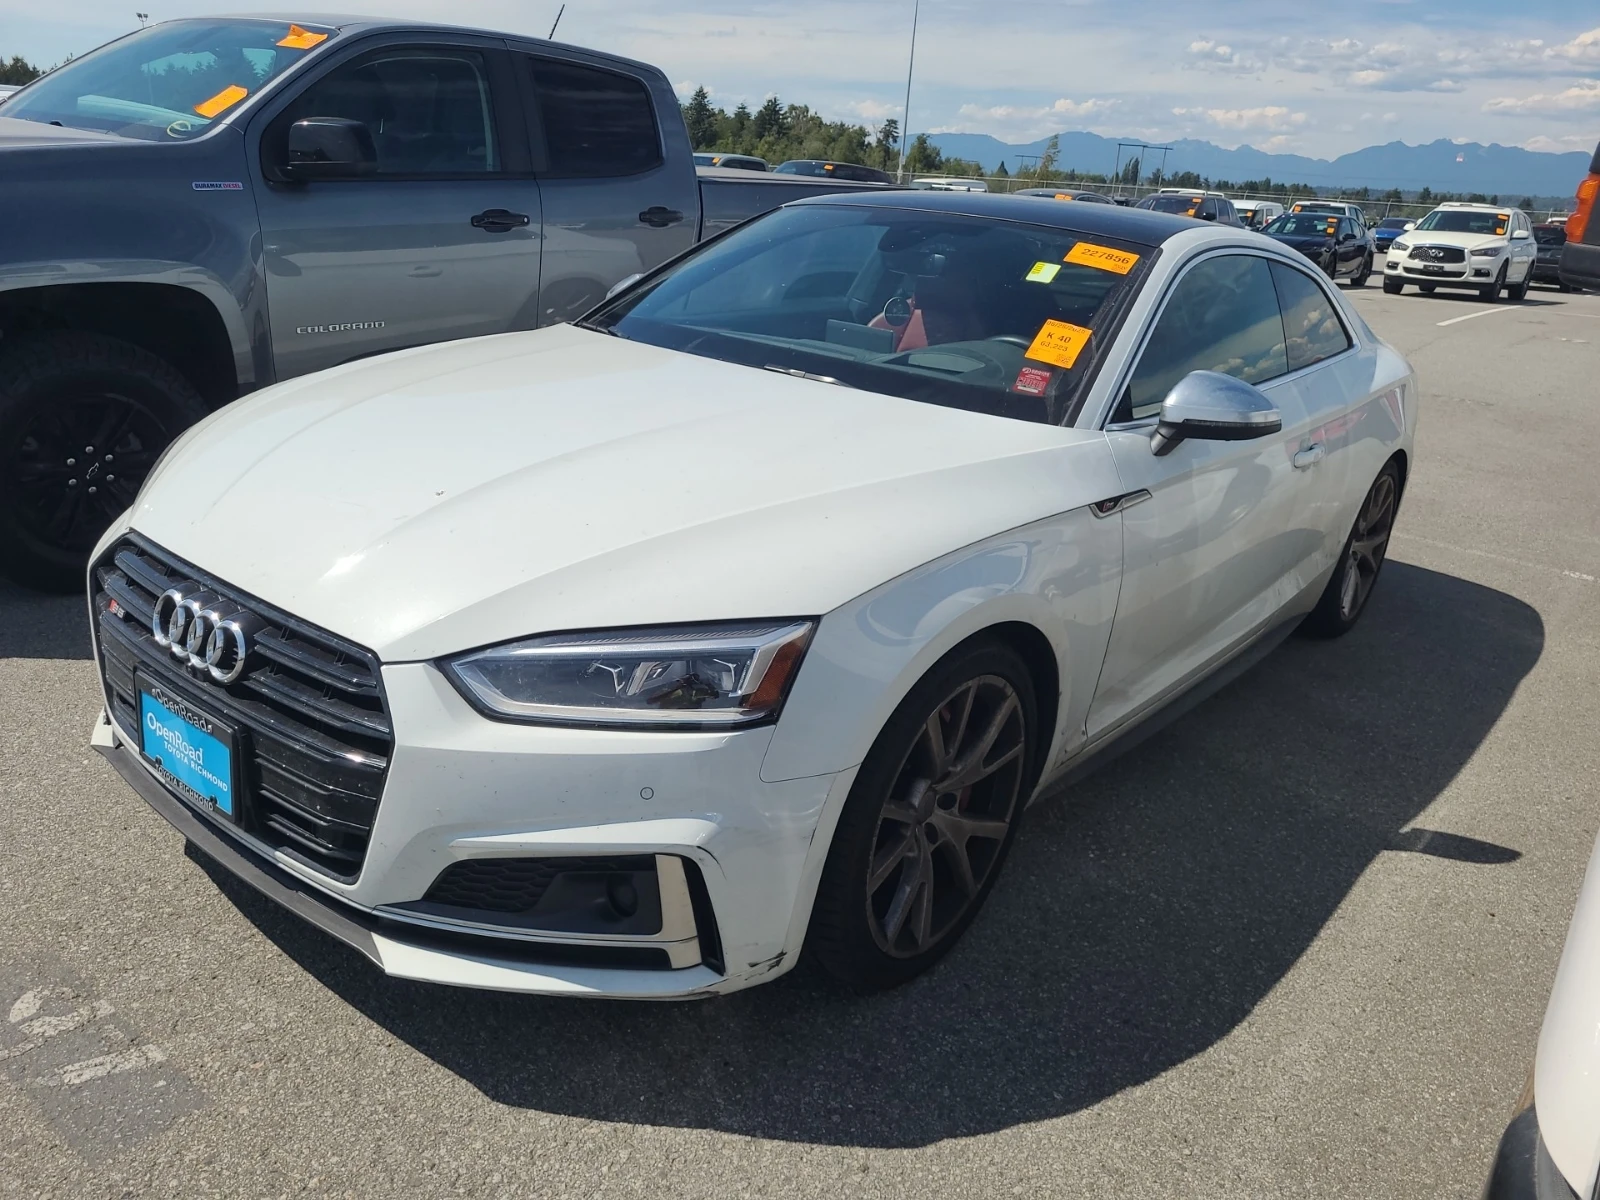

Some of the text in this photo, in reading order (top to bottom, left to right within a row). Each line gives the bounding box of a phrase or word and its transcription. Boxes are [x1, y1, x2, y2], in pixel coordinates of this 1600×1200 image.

[1080, 248, 1131, 264] 227856
[296, 321, 385, 334] COLORADO
[1046, 332, 1072, 344] K 40
[155, 689, 208, 733] OpenRoad
[147, 712, 204, 766] OpenRoad
[154, 764, 214, 811] TOYOTA RICHMOND
[163, 740, 228, 792] TOYOTA RICHMOND
